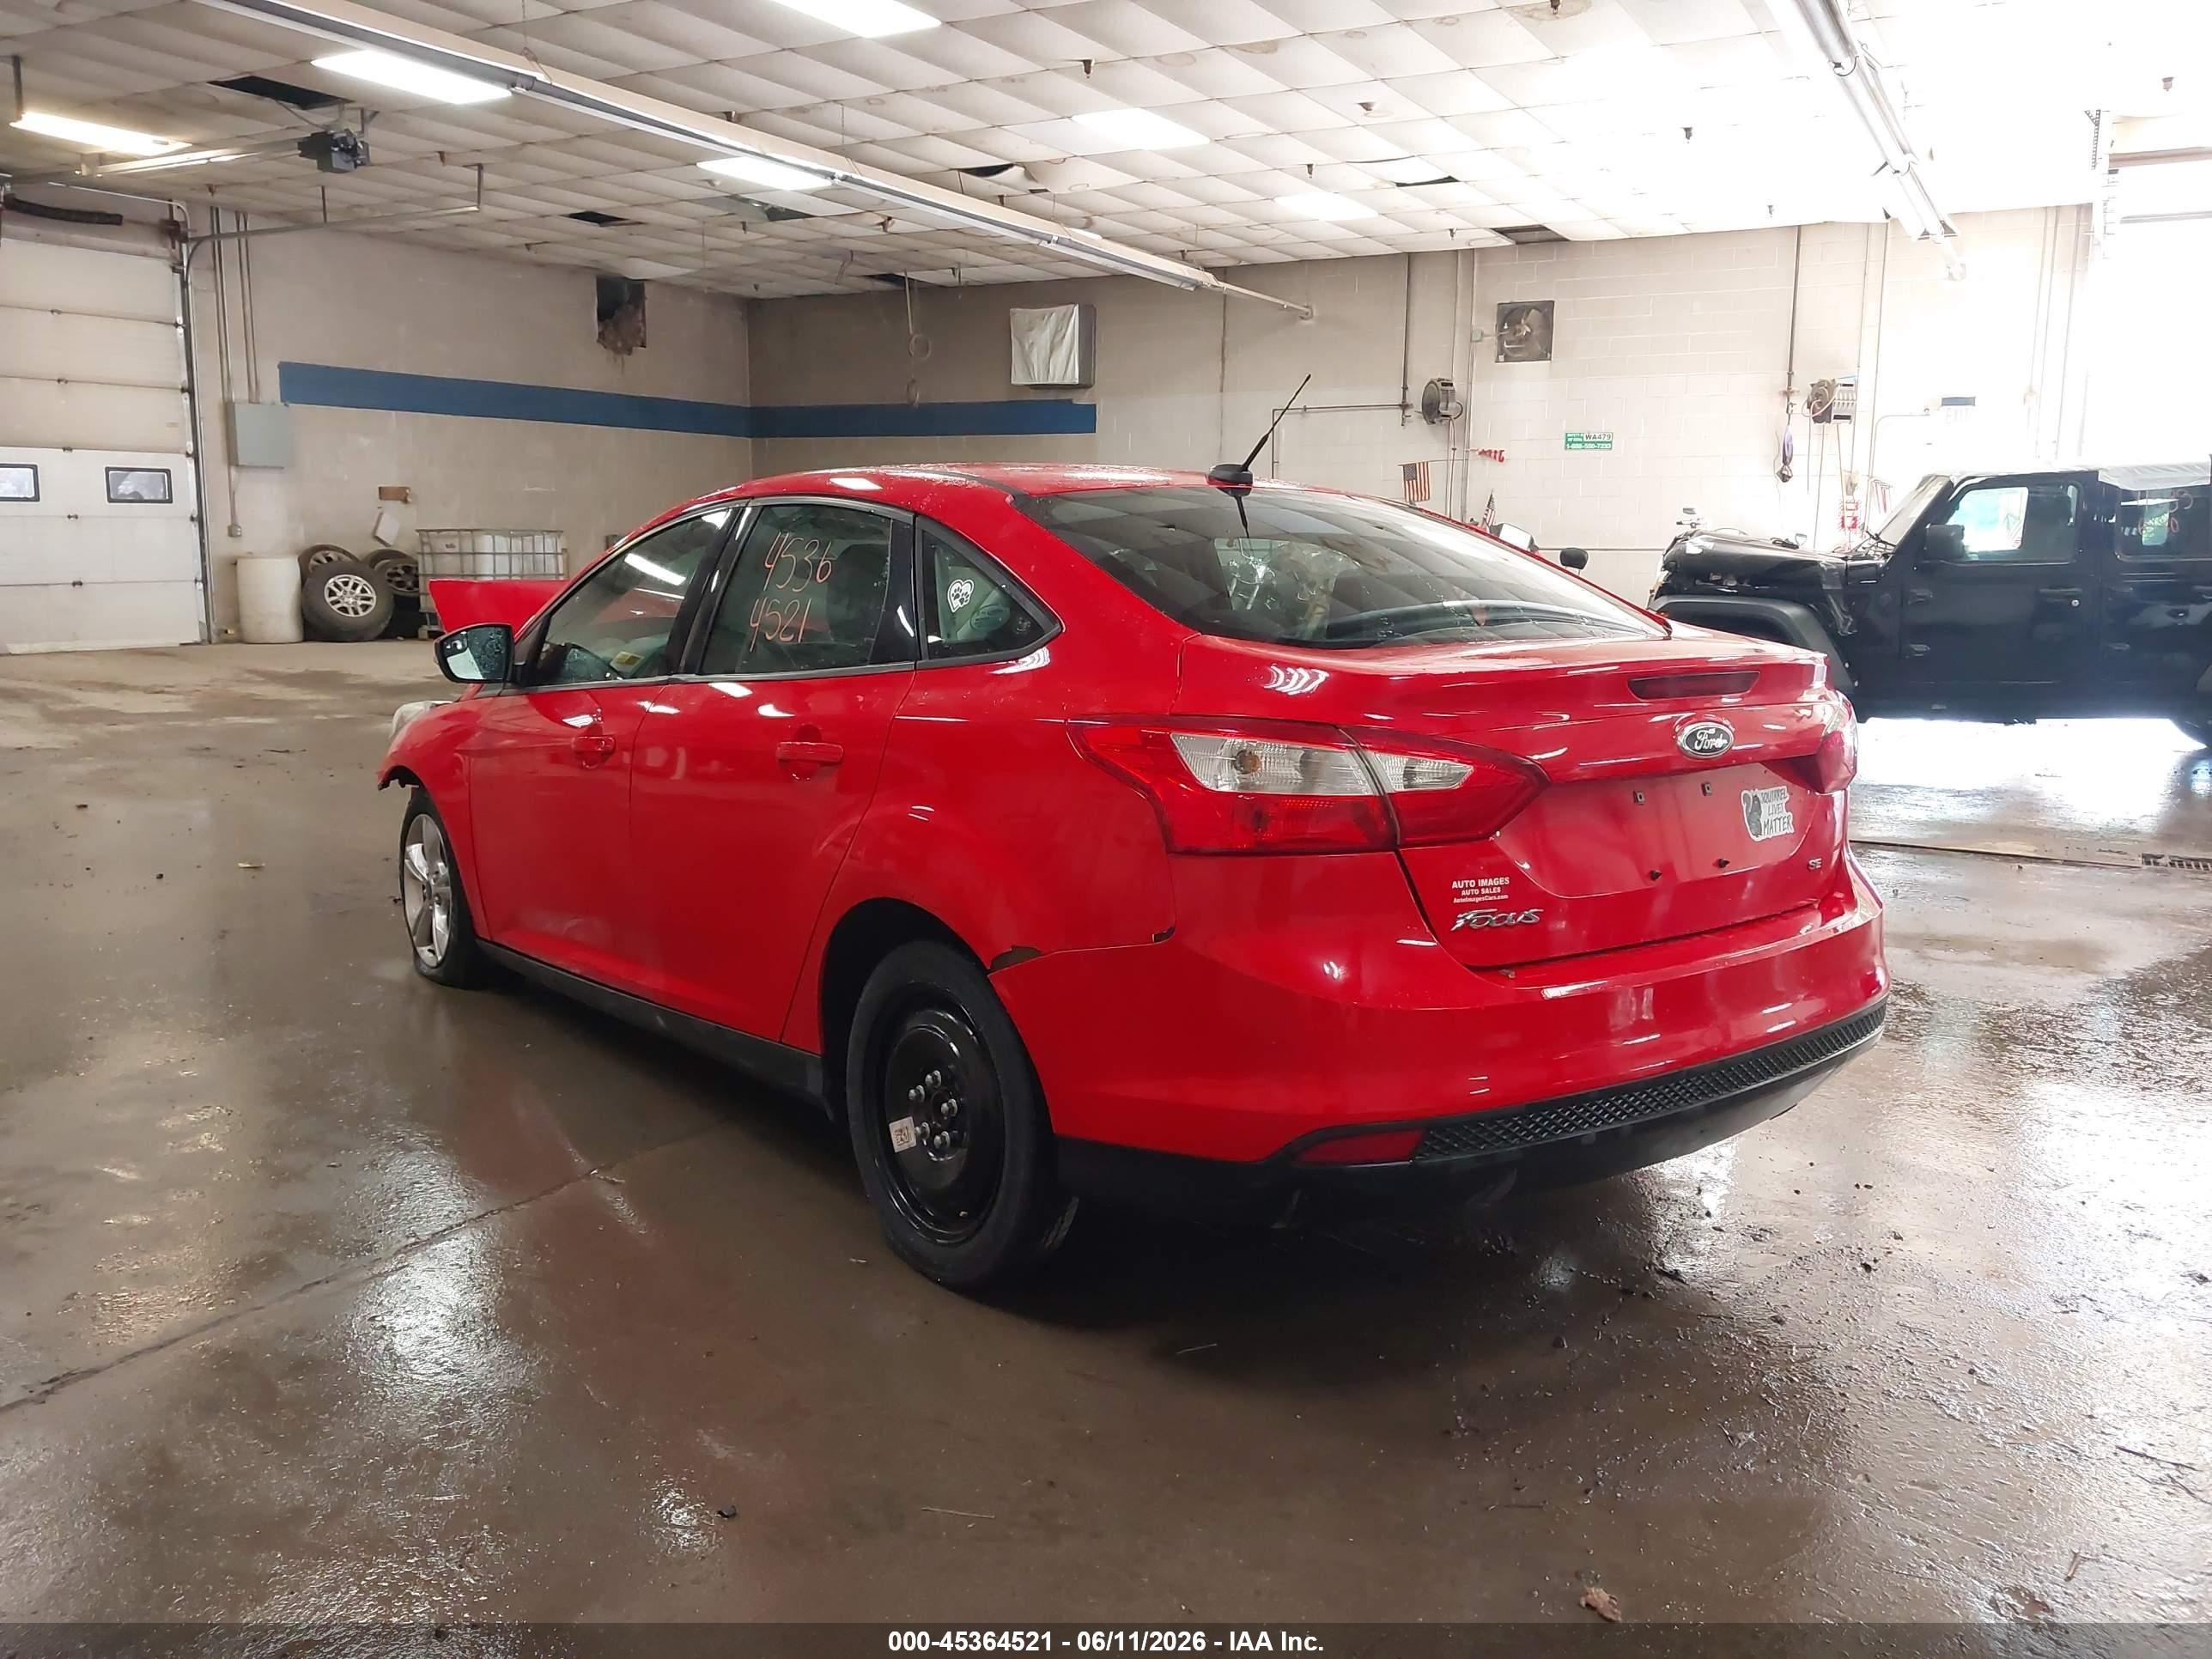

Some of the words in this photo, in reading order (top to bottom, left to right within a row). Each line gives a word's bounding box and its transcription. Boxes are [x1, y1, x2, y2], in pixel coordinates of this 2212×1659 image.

[763, 531, 833, 592] 4536
[749, 596, 812, 653] 4521
[1763, 815, 1792, 836] MATTER
[1808, 857, 1822, 870] SE
[1451, 879, 1476, 890] AUTO
[1478, 877, 1510, 887] IMAGES
[1462, 888, 1480, 896] AUTO
[1480, 886, 1501, 895] SALES
